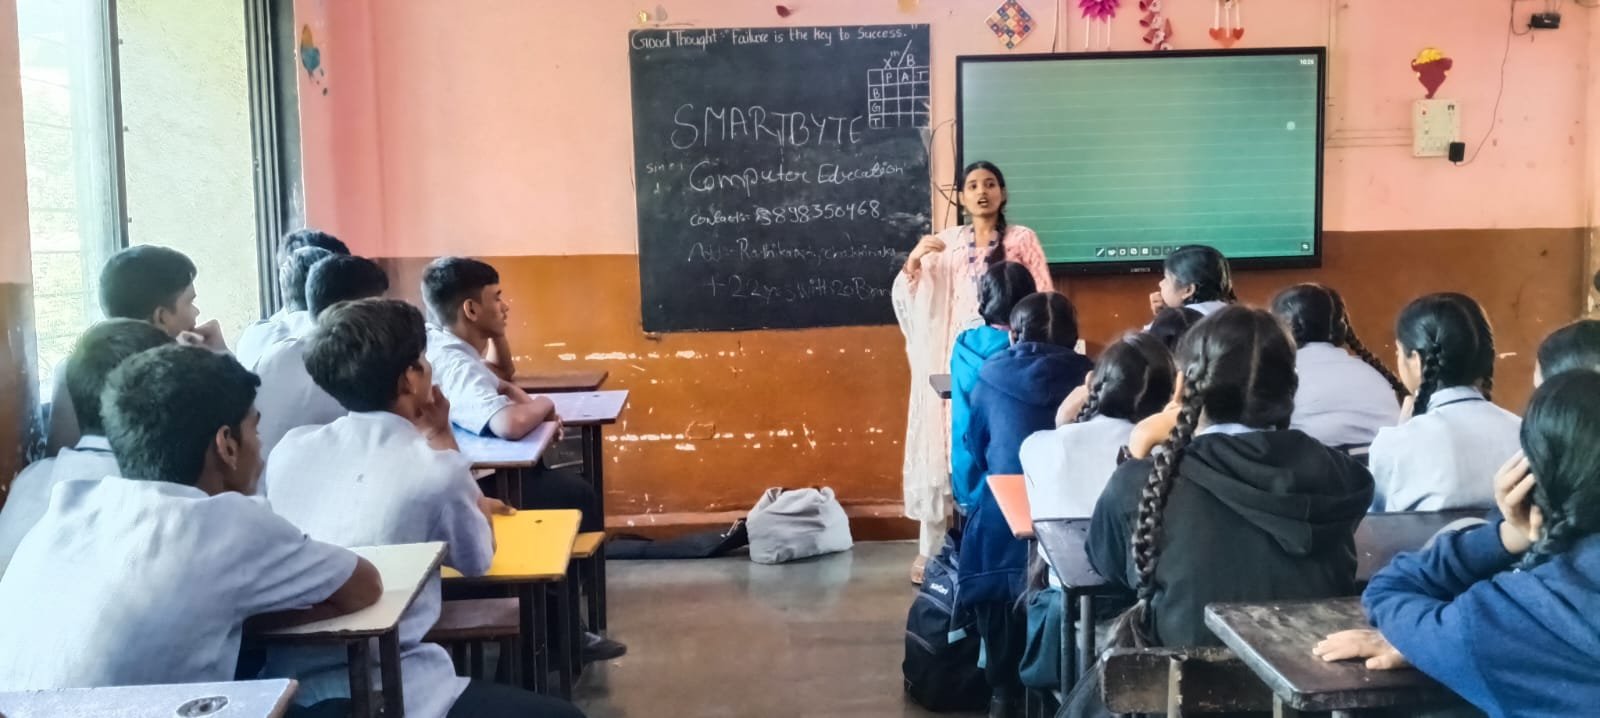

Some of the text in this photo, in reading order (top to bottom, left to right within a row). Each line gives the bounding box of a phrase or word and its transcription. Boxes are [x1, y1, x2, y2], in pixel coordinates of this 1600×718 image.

[774, 31, 784, 43] is
[789, 27, 808, 41] the
[839, 27, 850, 41] to
[885, 72, 893, 84] P
[901, 72, 909, 83] A
[671, 103, 863, 150] SMARTBYTE
[689, 160, 811, 198] Computer
